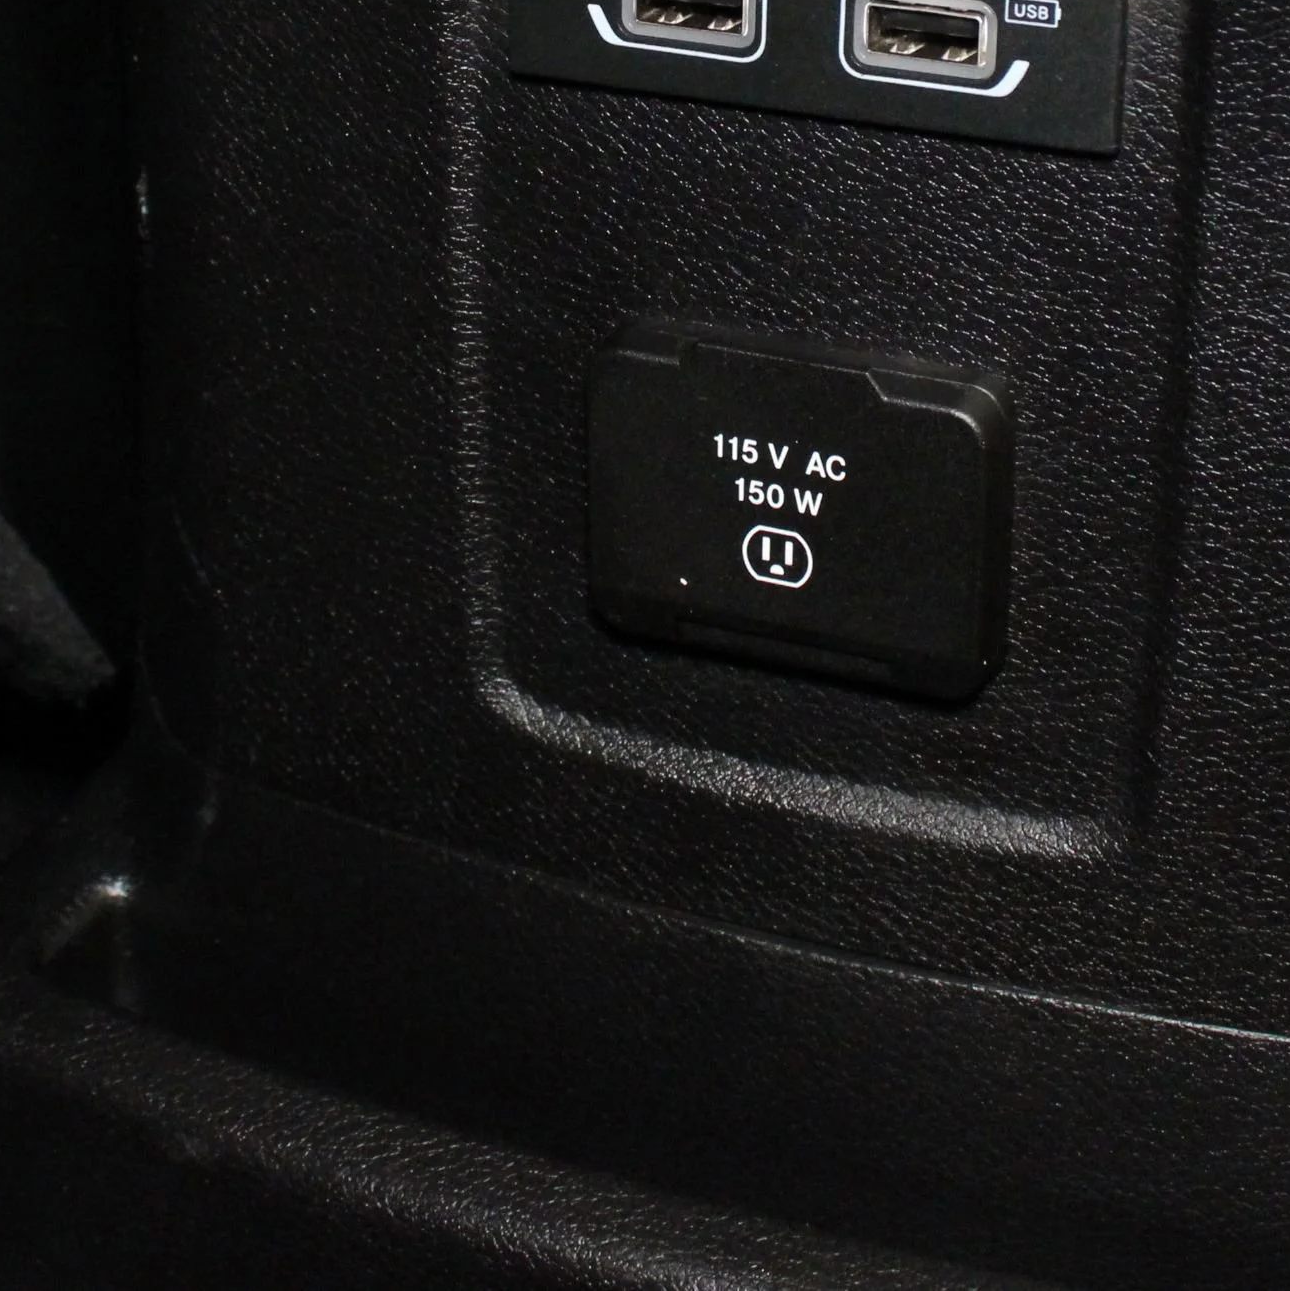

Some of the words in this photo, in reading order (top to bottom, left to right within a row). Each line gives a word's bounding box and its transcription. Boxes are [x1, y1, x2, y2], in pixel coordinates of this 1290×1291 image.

[1013, 2, 1050, 21] USB
[714, 433, 759, 464] 115
[767, 442, 790, 470] V
[805, 451, 847, 482] AC
[735, 477, 785, 509] 150
[793, 487, 824, 517] W
